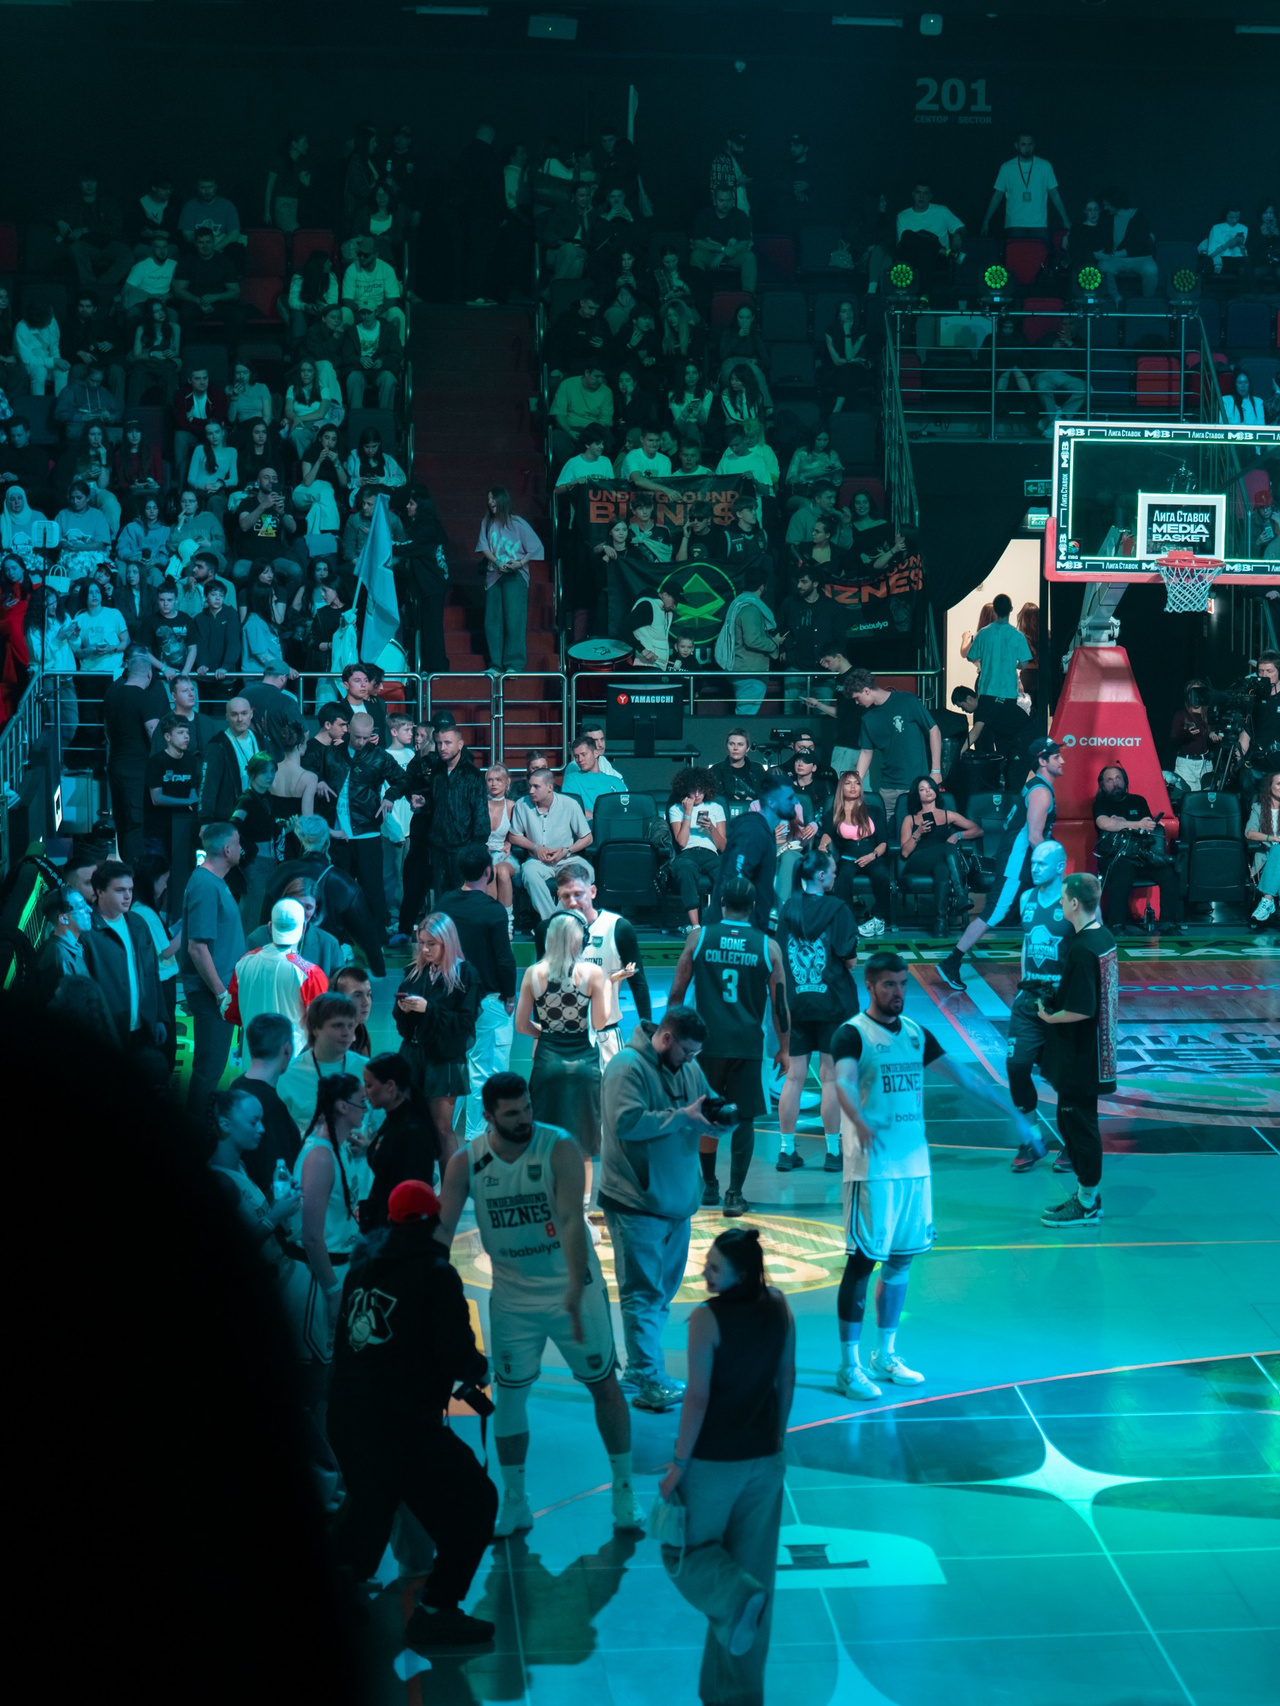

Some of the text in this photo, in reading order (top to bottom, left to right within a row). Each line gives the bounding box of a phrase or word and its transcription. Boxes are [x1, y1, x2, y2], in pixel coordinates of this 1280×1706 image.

[915, 77, 992, 112] 201
[914, 115, 992, 125] СЕКТОР SECTOR
[588, 489, 740, 504] UNDGOUND
[1153, 510, 1210, 523] ЛИГА СТАВОК
[1152, 523, 1209, 534] MEDIA
[1152, 534, 1210, 543] BASKET
[630, 695, 674, 704] YAMAGUCHI
[1079, 736, 1142, 747] самокат
[719, 936, 747, 952] BONE
[705, 949, 759, 967] COLLECTOR
[722, 968, 739, 1003] 3
[881, 1072, 922, 1094] BIZNE
[486, 1192, 547, 1210] UNDERGROUND
[488, 1203, 551, 1229] BIZNES
[545, 1222, 557, 1238] 8
[509, 1240, 561, 1259] babulya
